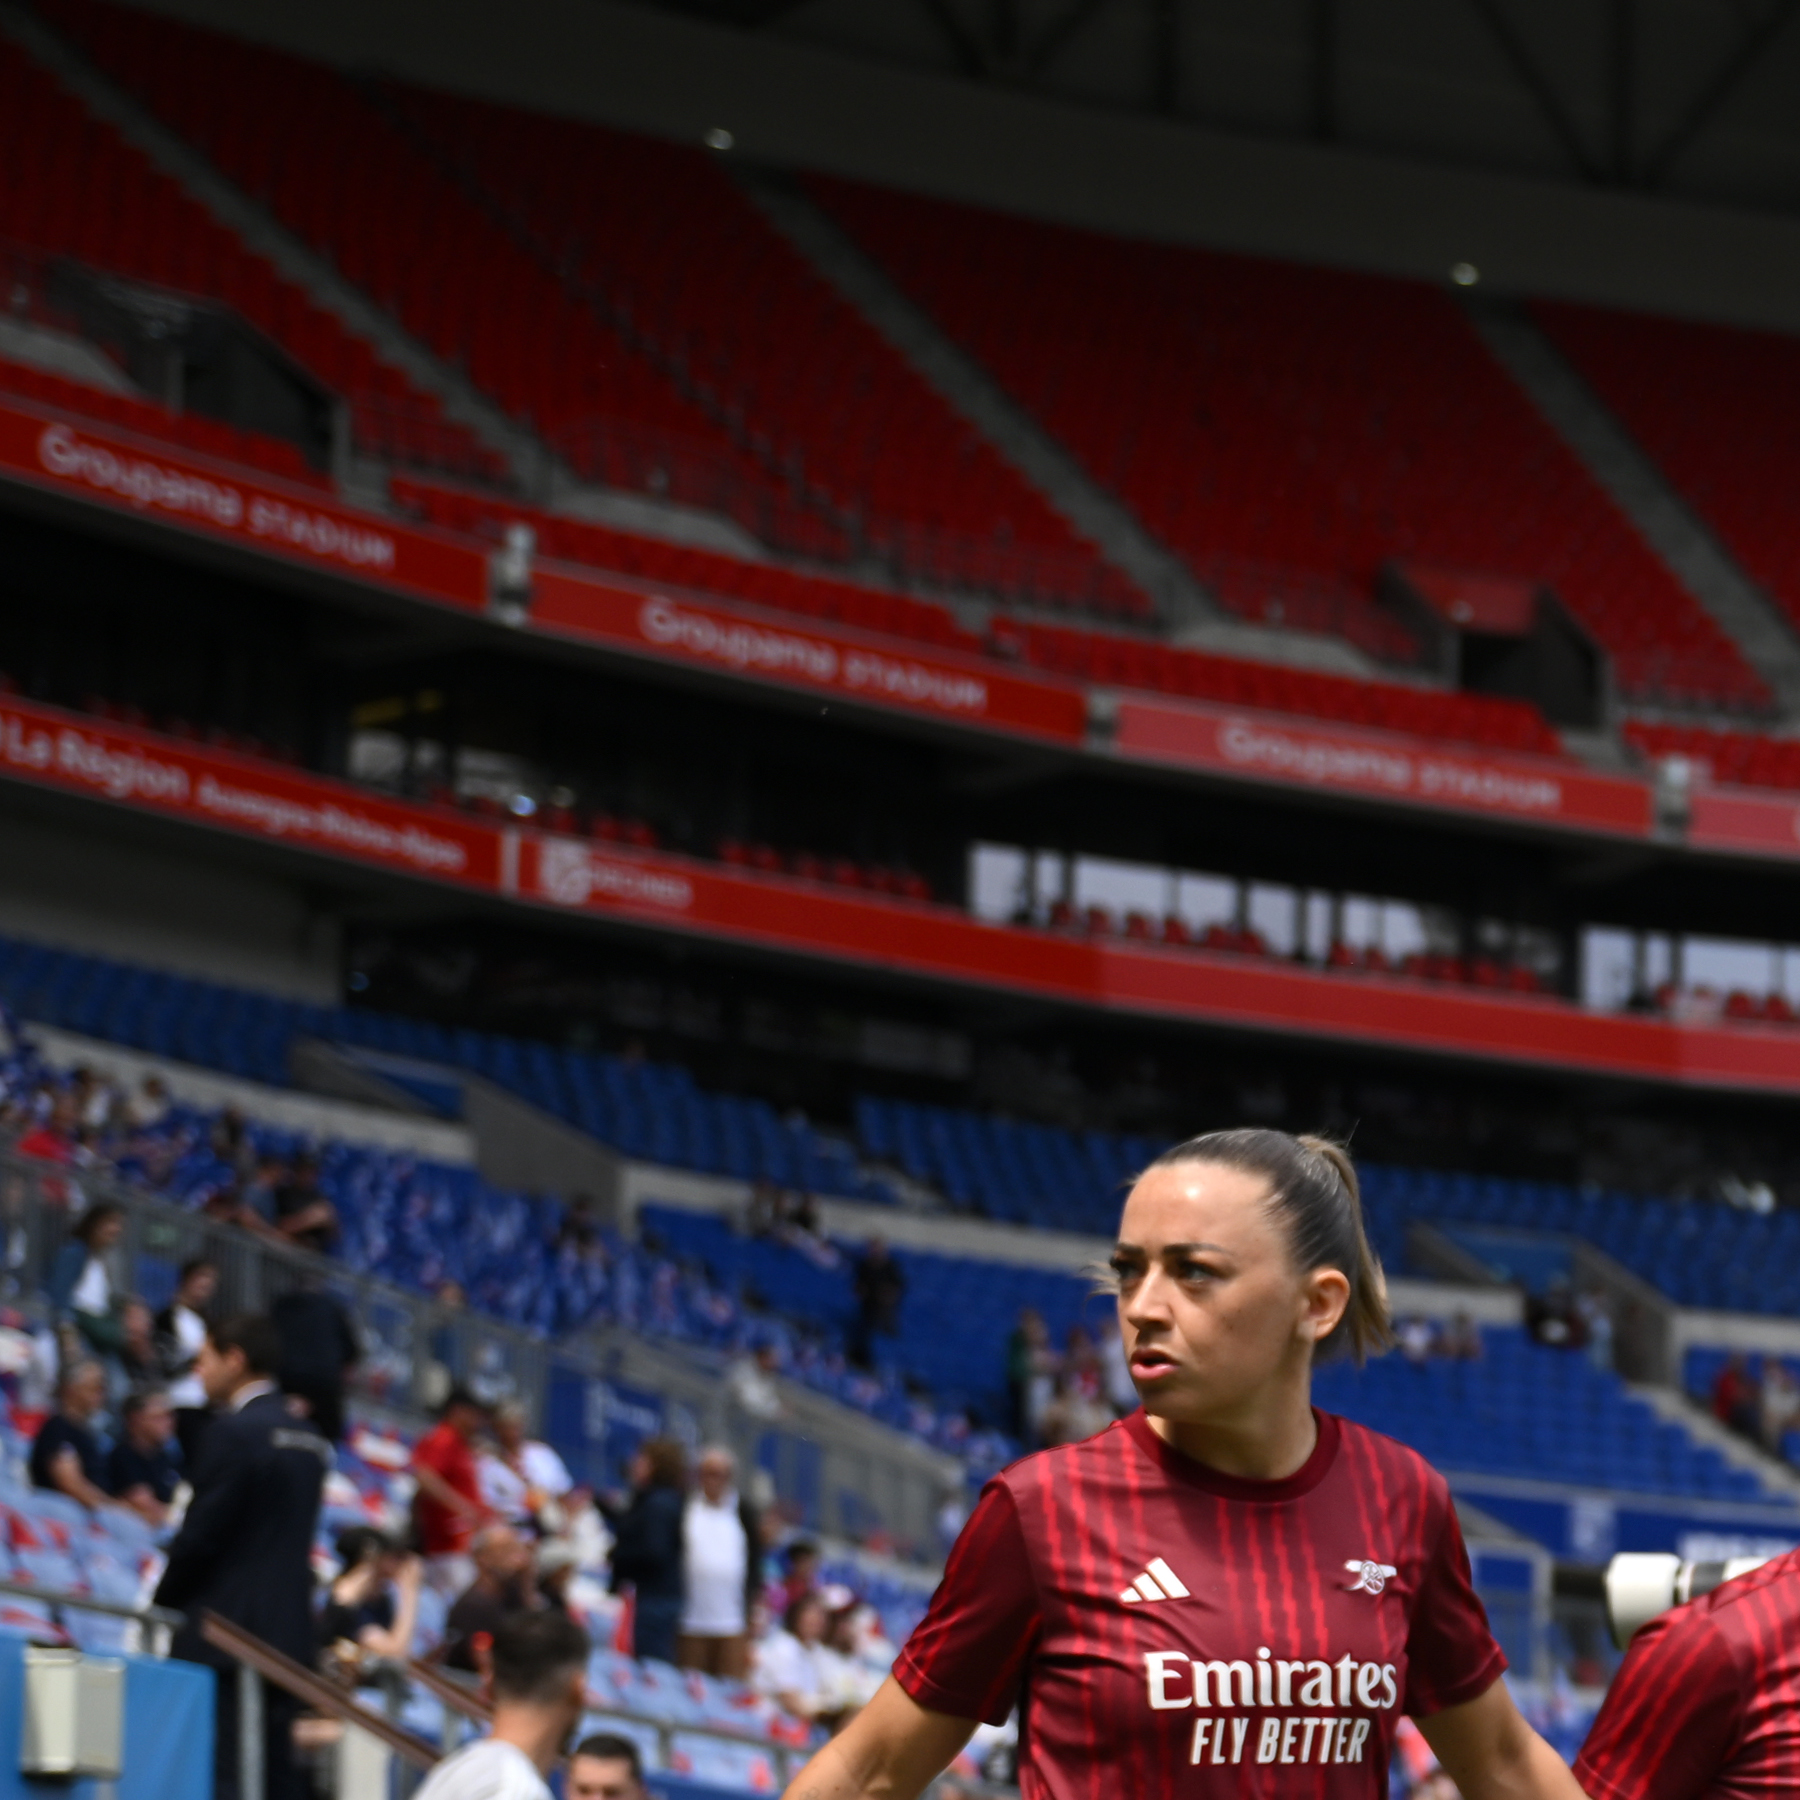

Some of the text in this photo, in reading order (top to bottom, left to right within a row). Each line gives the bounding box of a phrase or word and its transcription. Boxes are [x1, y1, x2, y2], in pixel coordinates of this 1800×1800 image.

[39, 424, 243, 526] Groupama
[641, 597, 837, 679] Groupama
[1218, 719, 1408, 790] Groupama
[1143, 1647, 1398, 1710] Emirates
[1190, 1717, 1371, 1765] FLY BETTER
